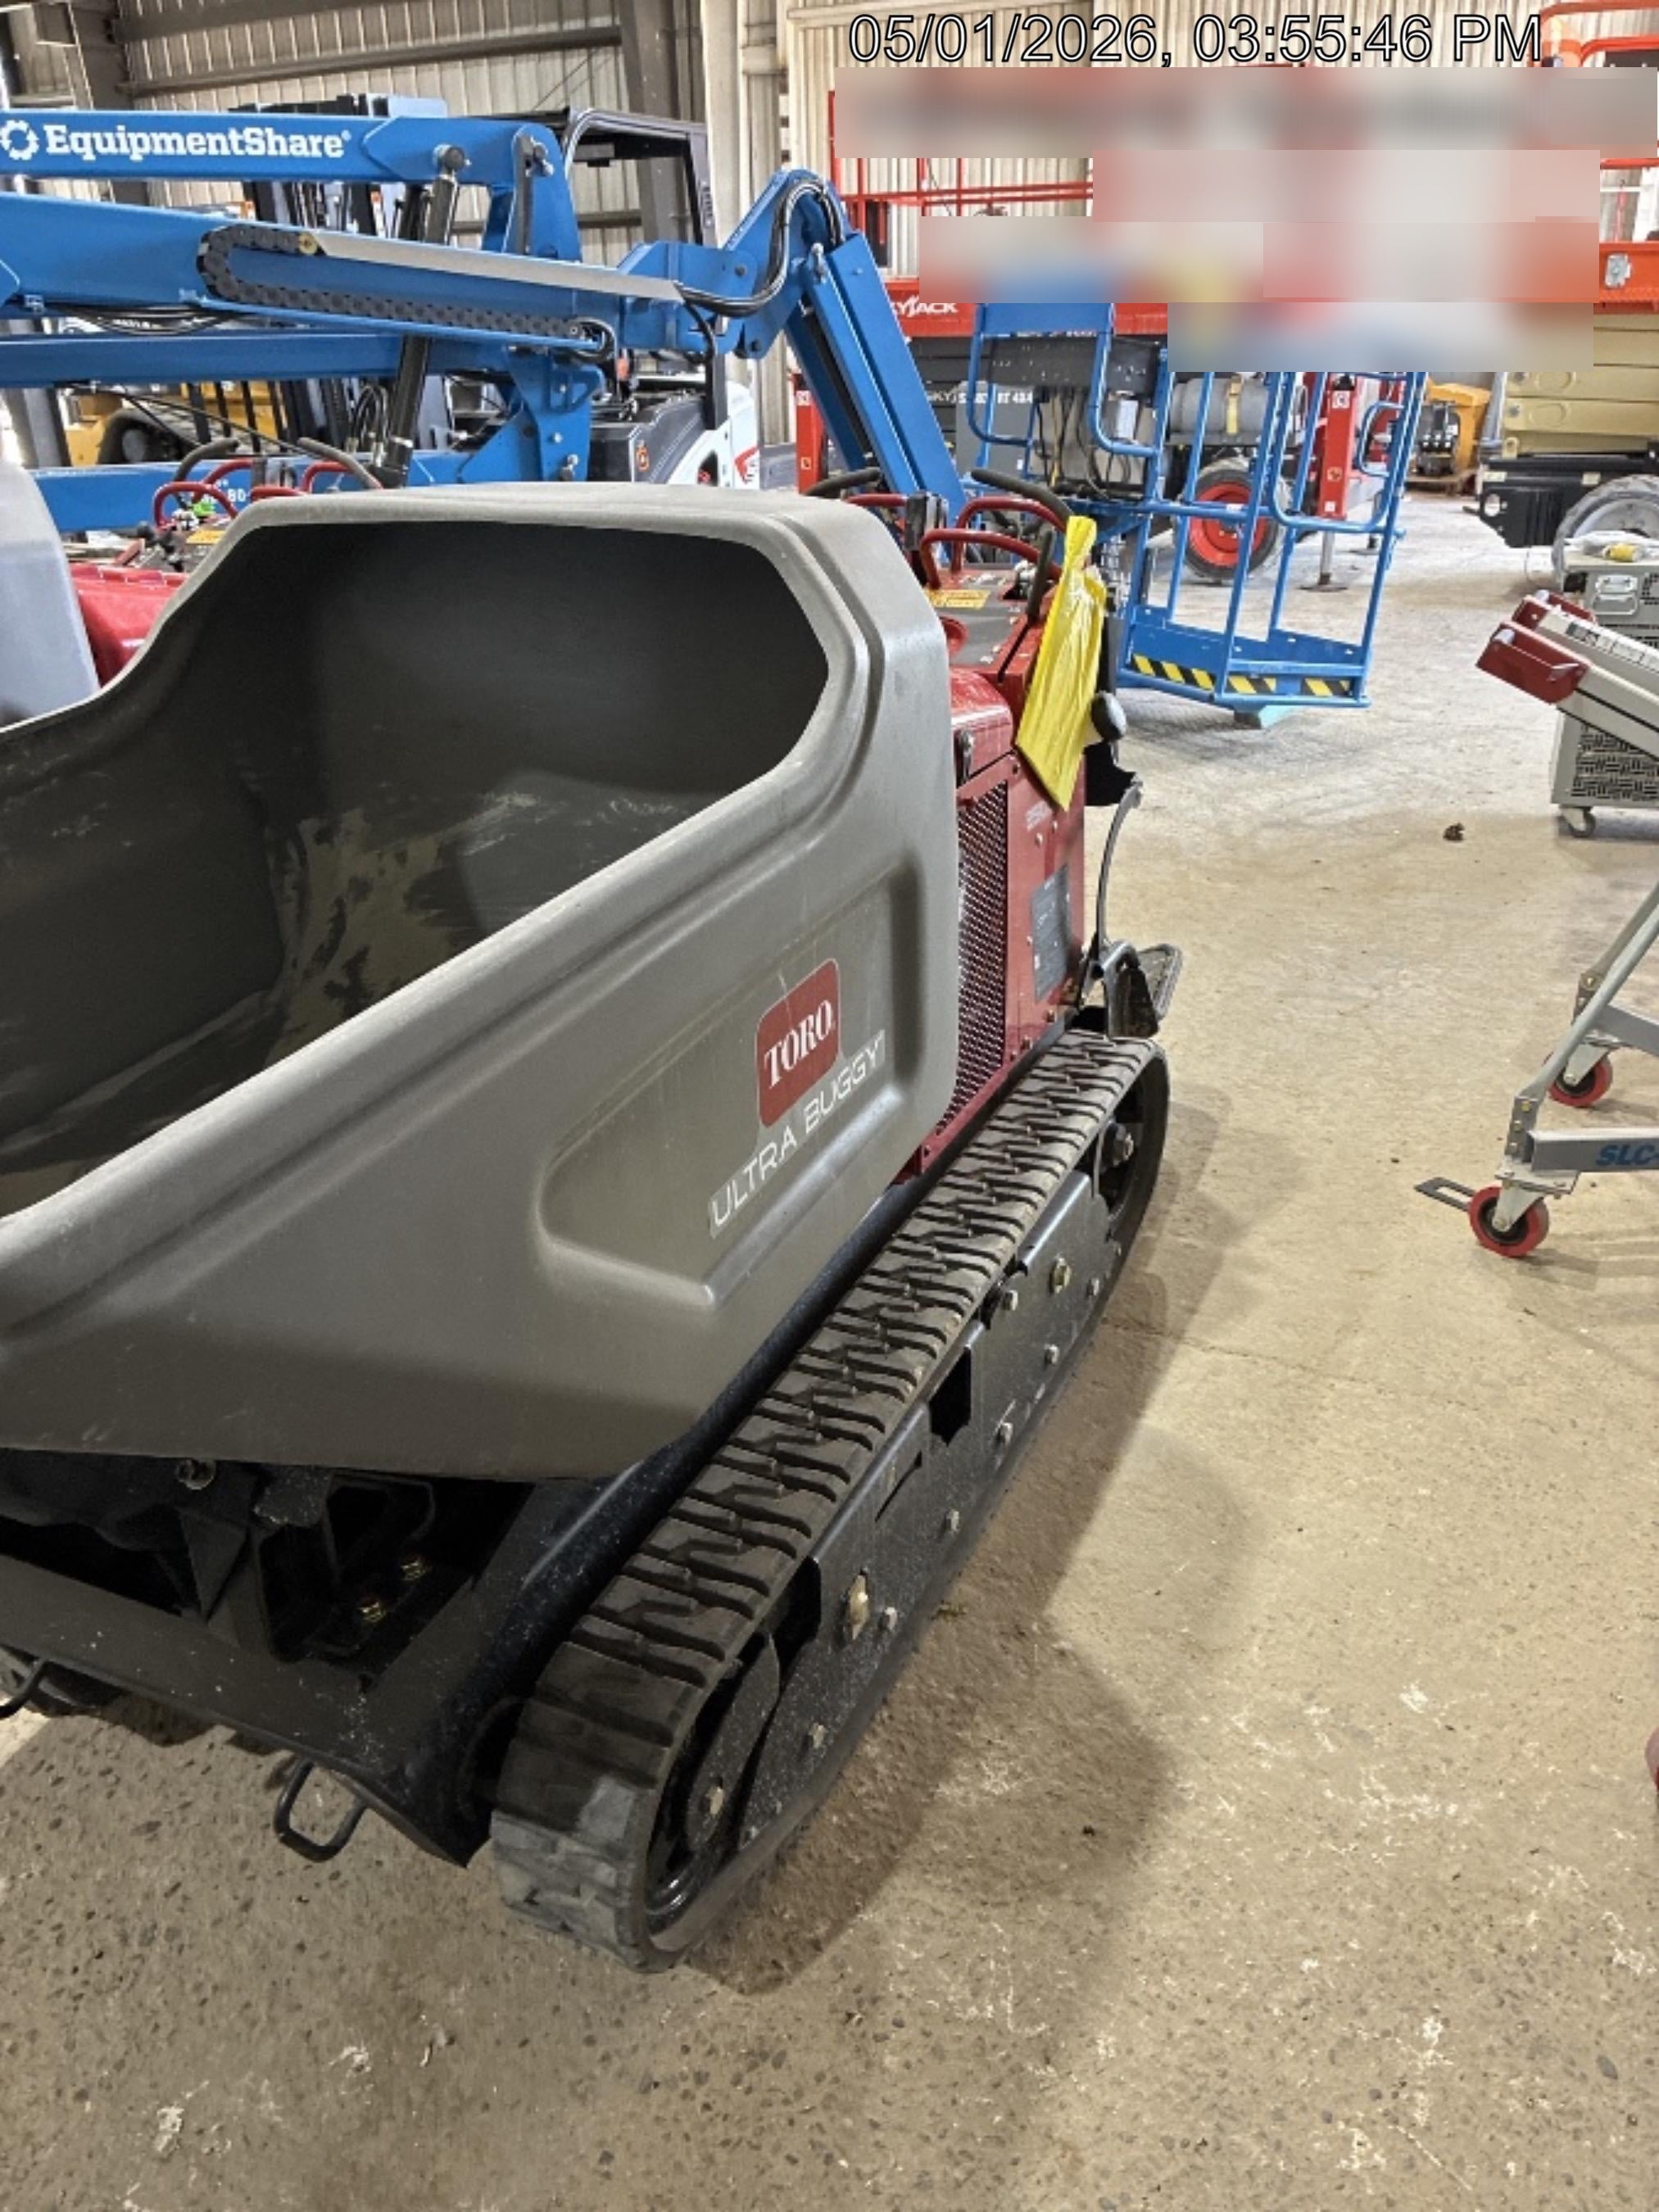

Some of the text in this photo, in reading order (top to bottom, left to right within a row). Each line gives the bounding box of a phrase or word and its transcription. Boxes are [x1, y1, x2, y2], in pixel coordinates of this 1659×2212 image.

[43, 125, 345, 161] EquipmentShare
[891, 294, 959, 318] YJACK
[764, 999, 833, 1090] TORO
[711, 1035, 882, 1227] ULTRA BUGGY
